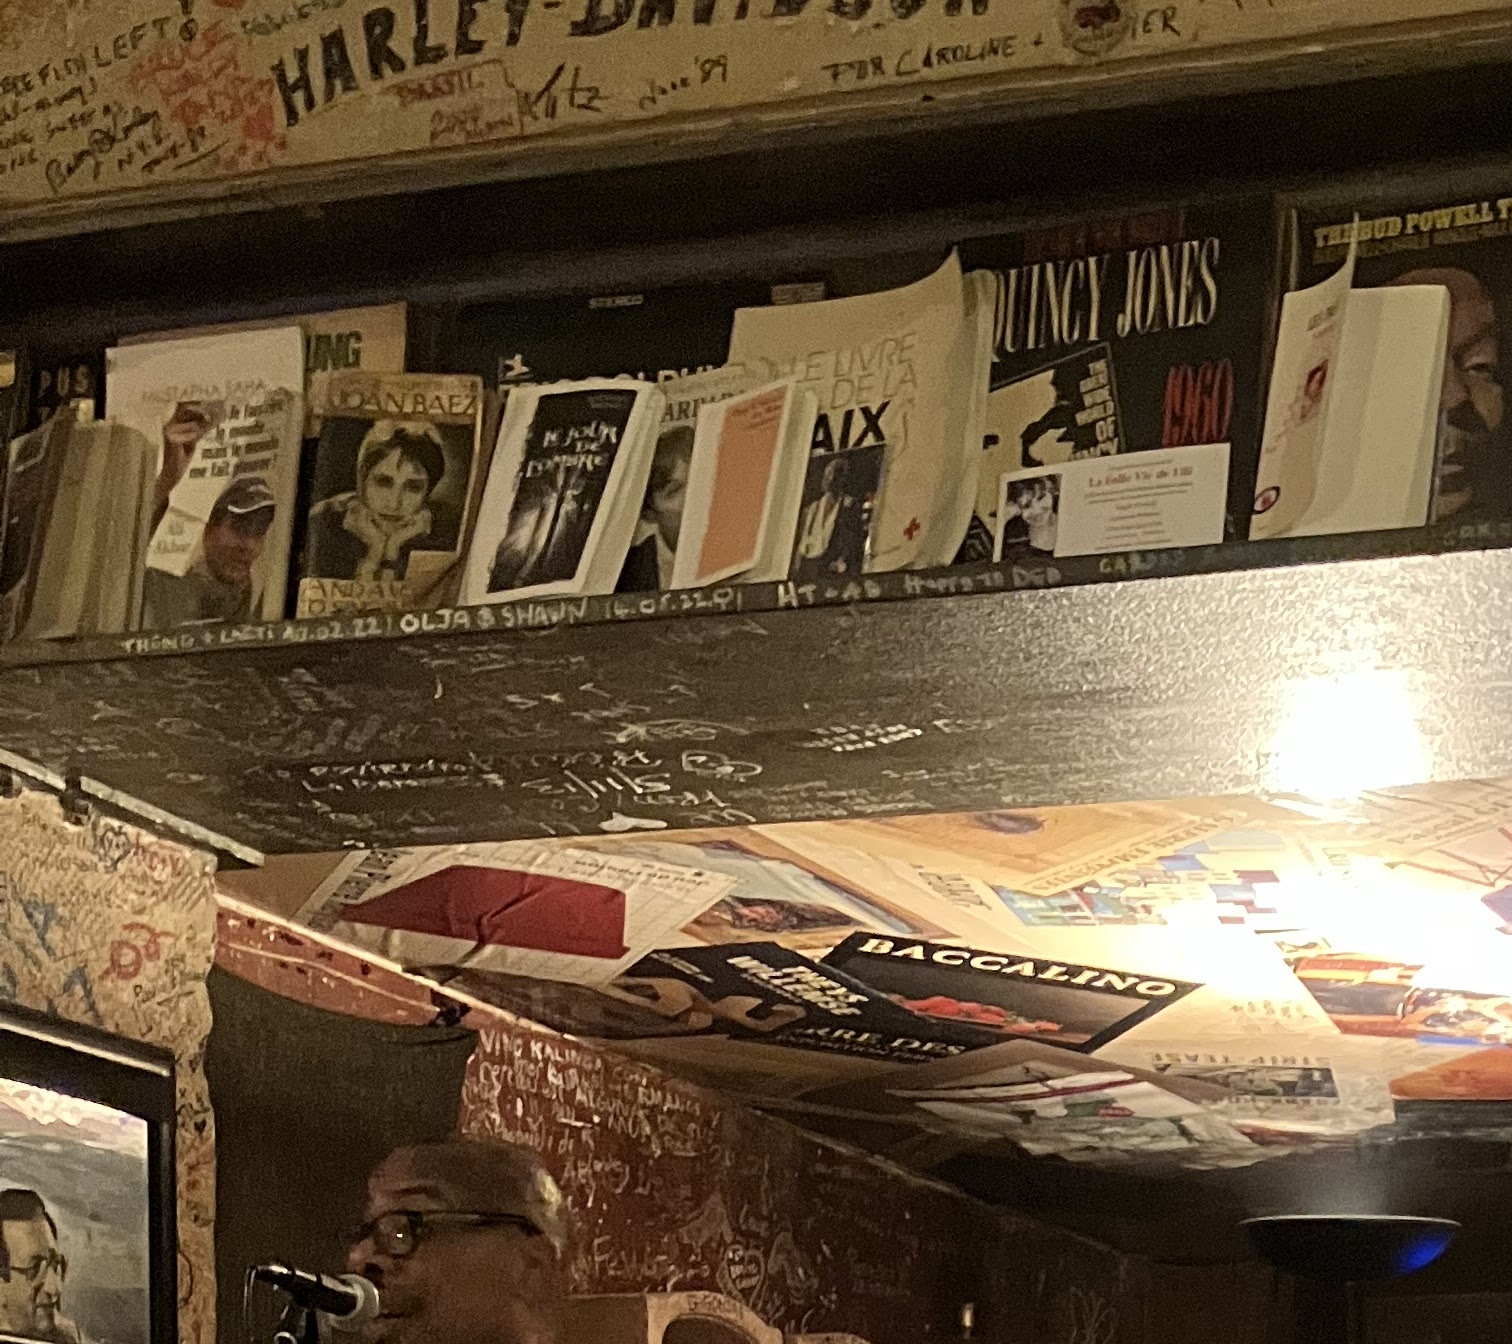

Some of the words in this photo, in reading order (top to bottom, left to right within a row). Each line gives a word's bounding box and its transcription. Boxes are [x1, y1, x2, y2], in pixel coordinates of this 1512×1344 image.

[1404, 201, 1494, 233] POWELL
[1117, 236, 1221, 338] JONES
[856, 937, 1178, 996] BACCALINO
